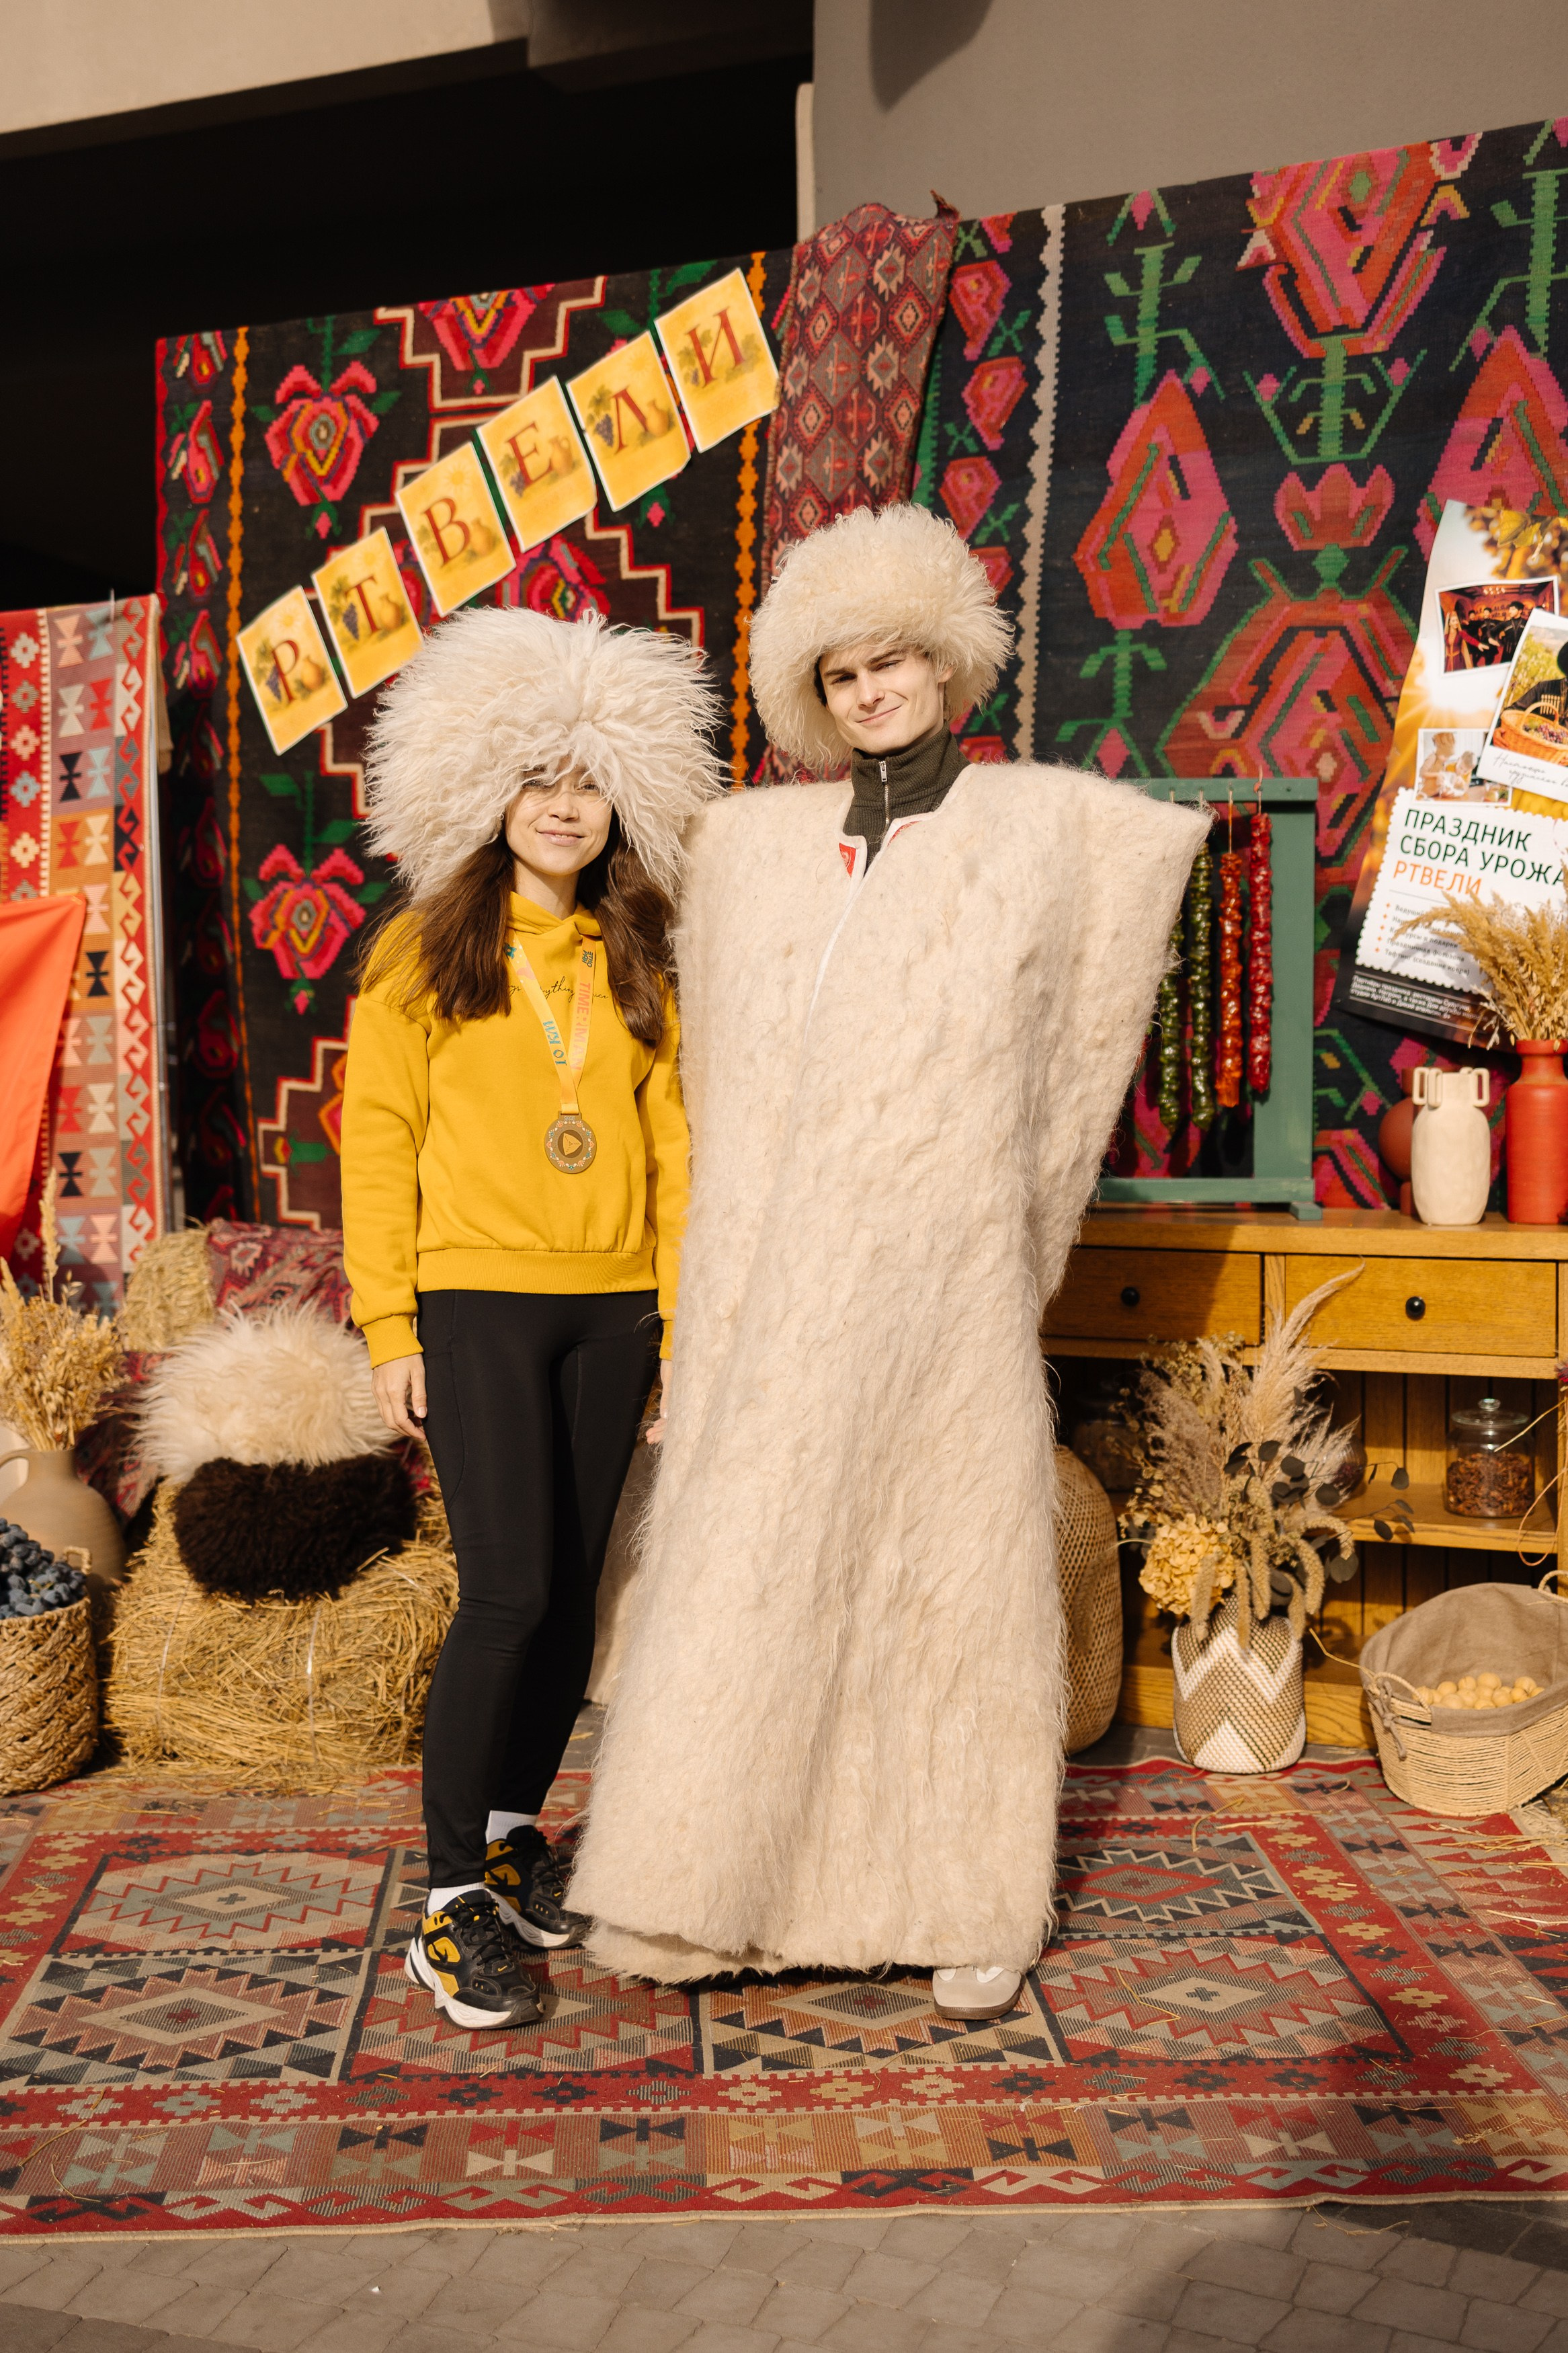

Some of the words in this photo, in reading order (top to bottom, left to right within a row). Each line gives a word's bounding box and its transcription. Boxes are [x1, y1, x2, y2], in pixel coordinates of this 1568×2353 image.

[271, 307, 748, 705] РТВЕЛИ
[1404, 809, 1532, 852] ПРАЗДНИК
[1400, 834, 1469, 867] СБОРА
[1393, 860, 1482, 896] РТВЕЛИ
[1430, 938, 1458, 949] подарки
